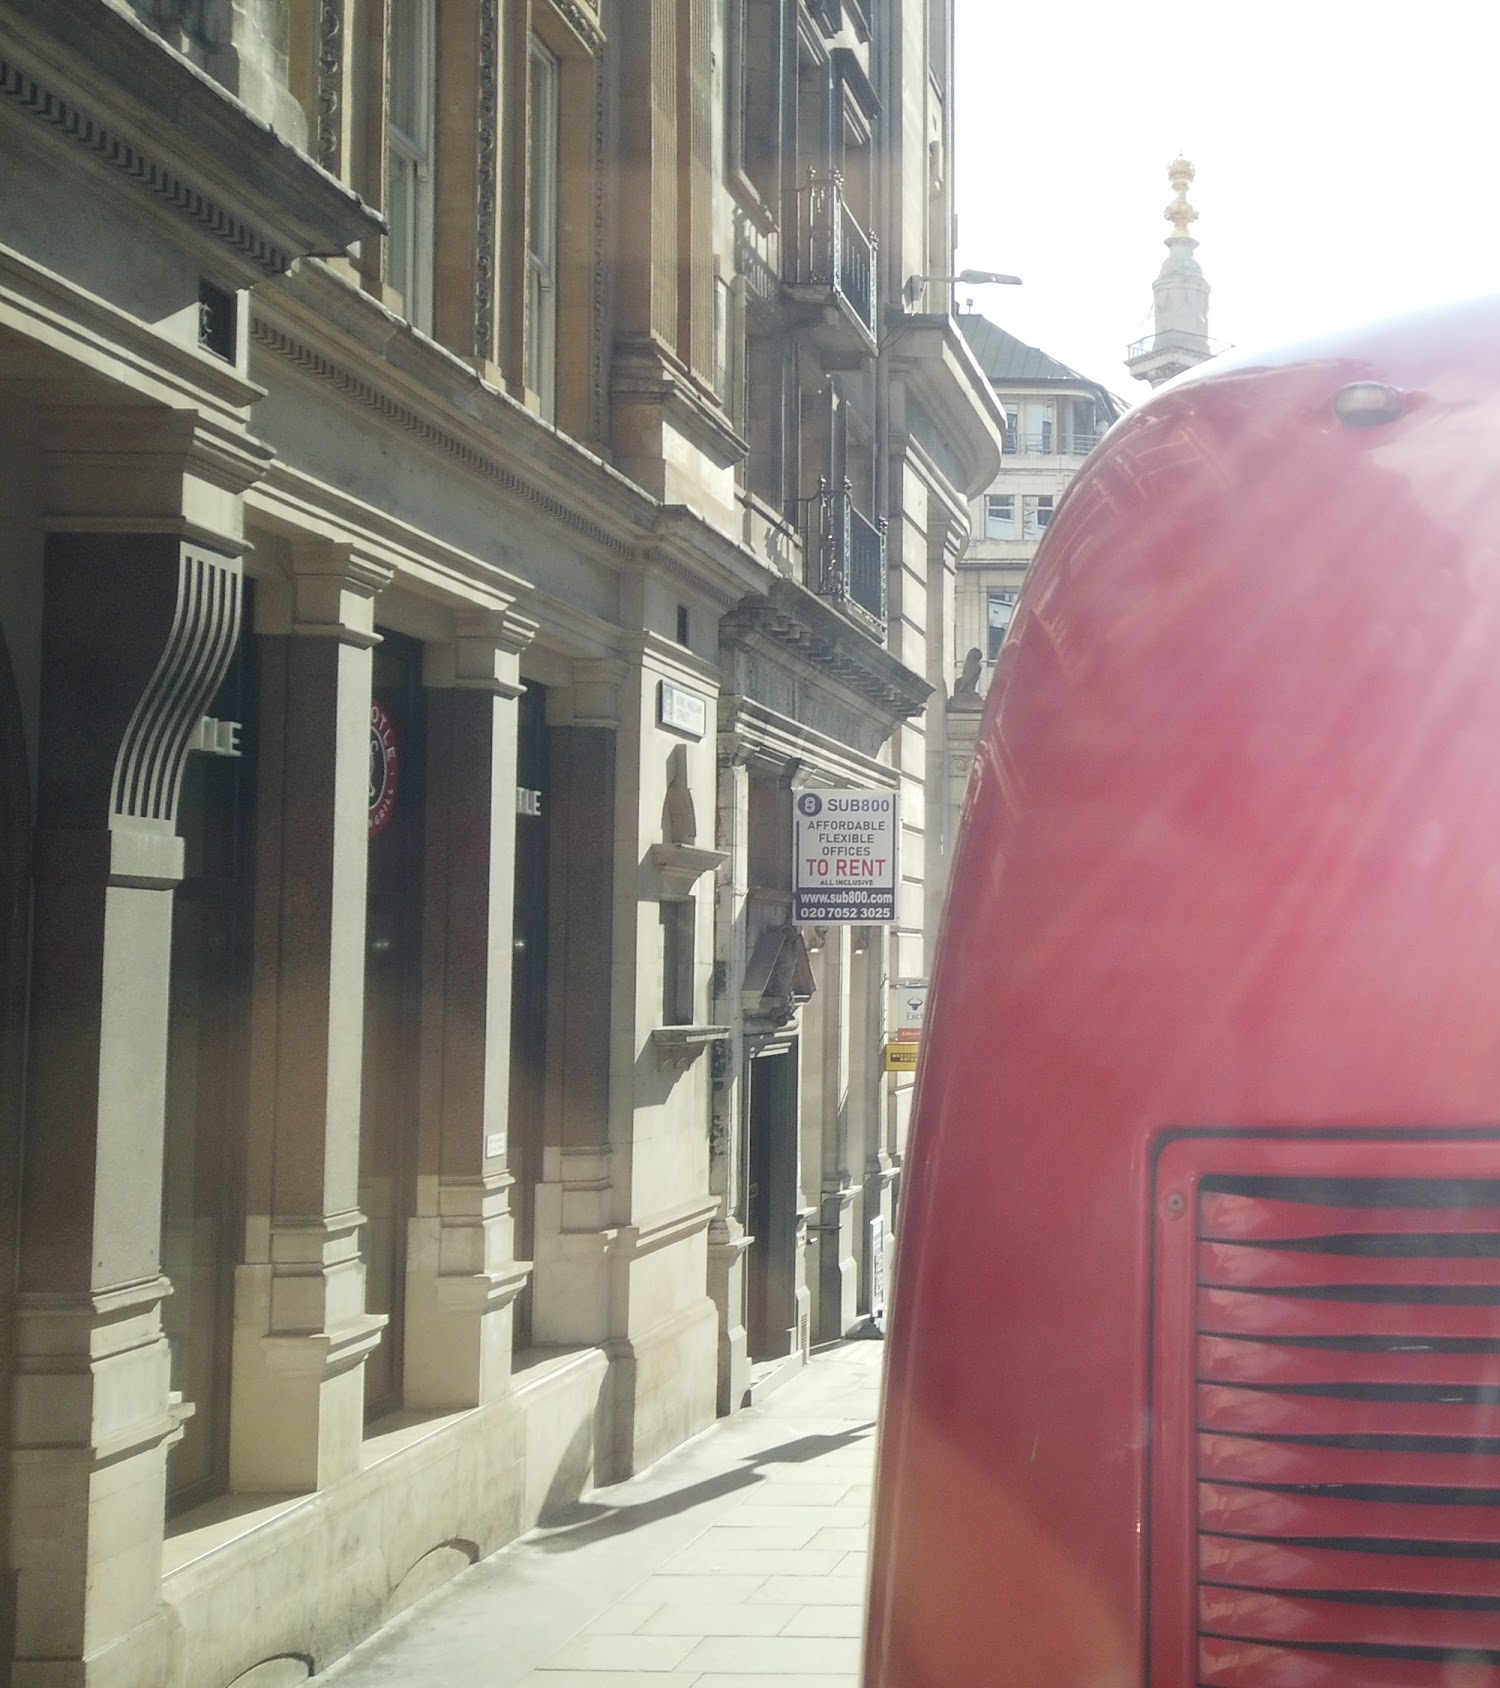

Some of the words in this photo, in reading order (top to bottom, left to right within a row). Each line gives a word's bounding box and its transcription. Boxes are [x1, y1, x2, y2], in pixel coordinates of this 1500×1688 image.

[827, 798, 890, 812] SUB800
[807, 820, 886, 831] AFFORDABLE
[818, 833, 875, 844] FLEXIBLE
[821, 846, 871, 856] OFFICES
[806, 858, 829, 877] TO
[836, 859, 886, 877] RENT
[800, 890, 893, 904] www.sub800.com
[800, 907, 826, 919] 020
[827, 907, 857, 918] 7052
[860, 907, 891, 918] 3025
